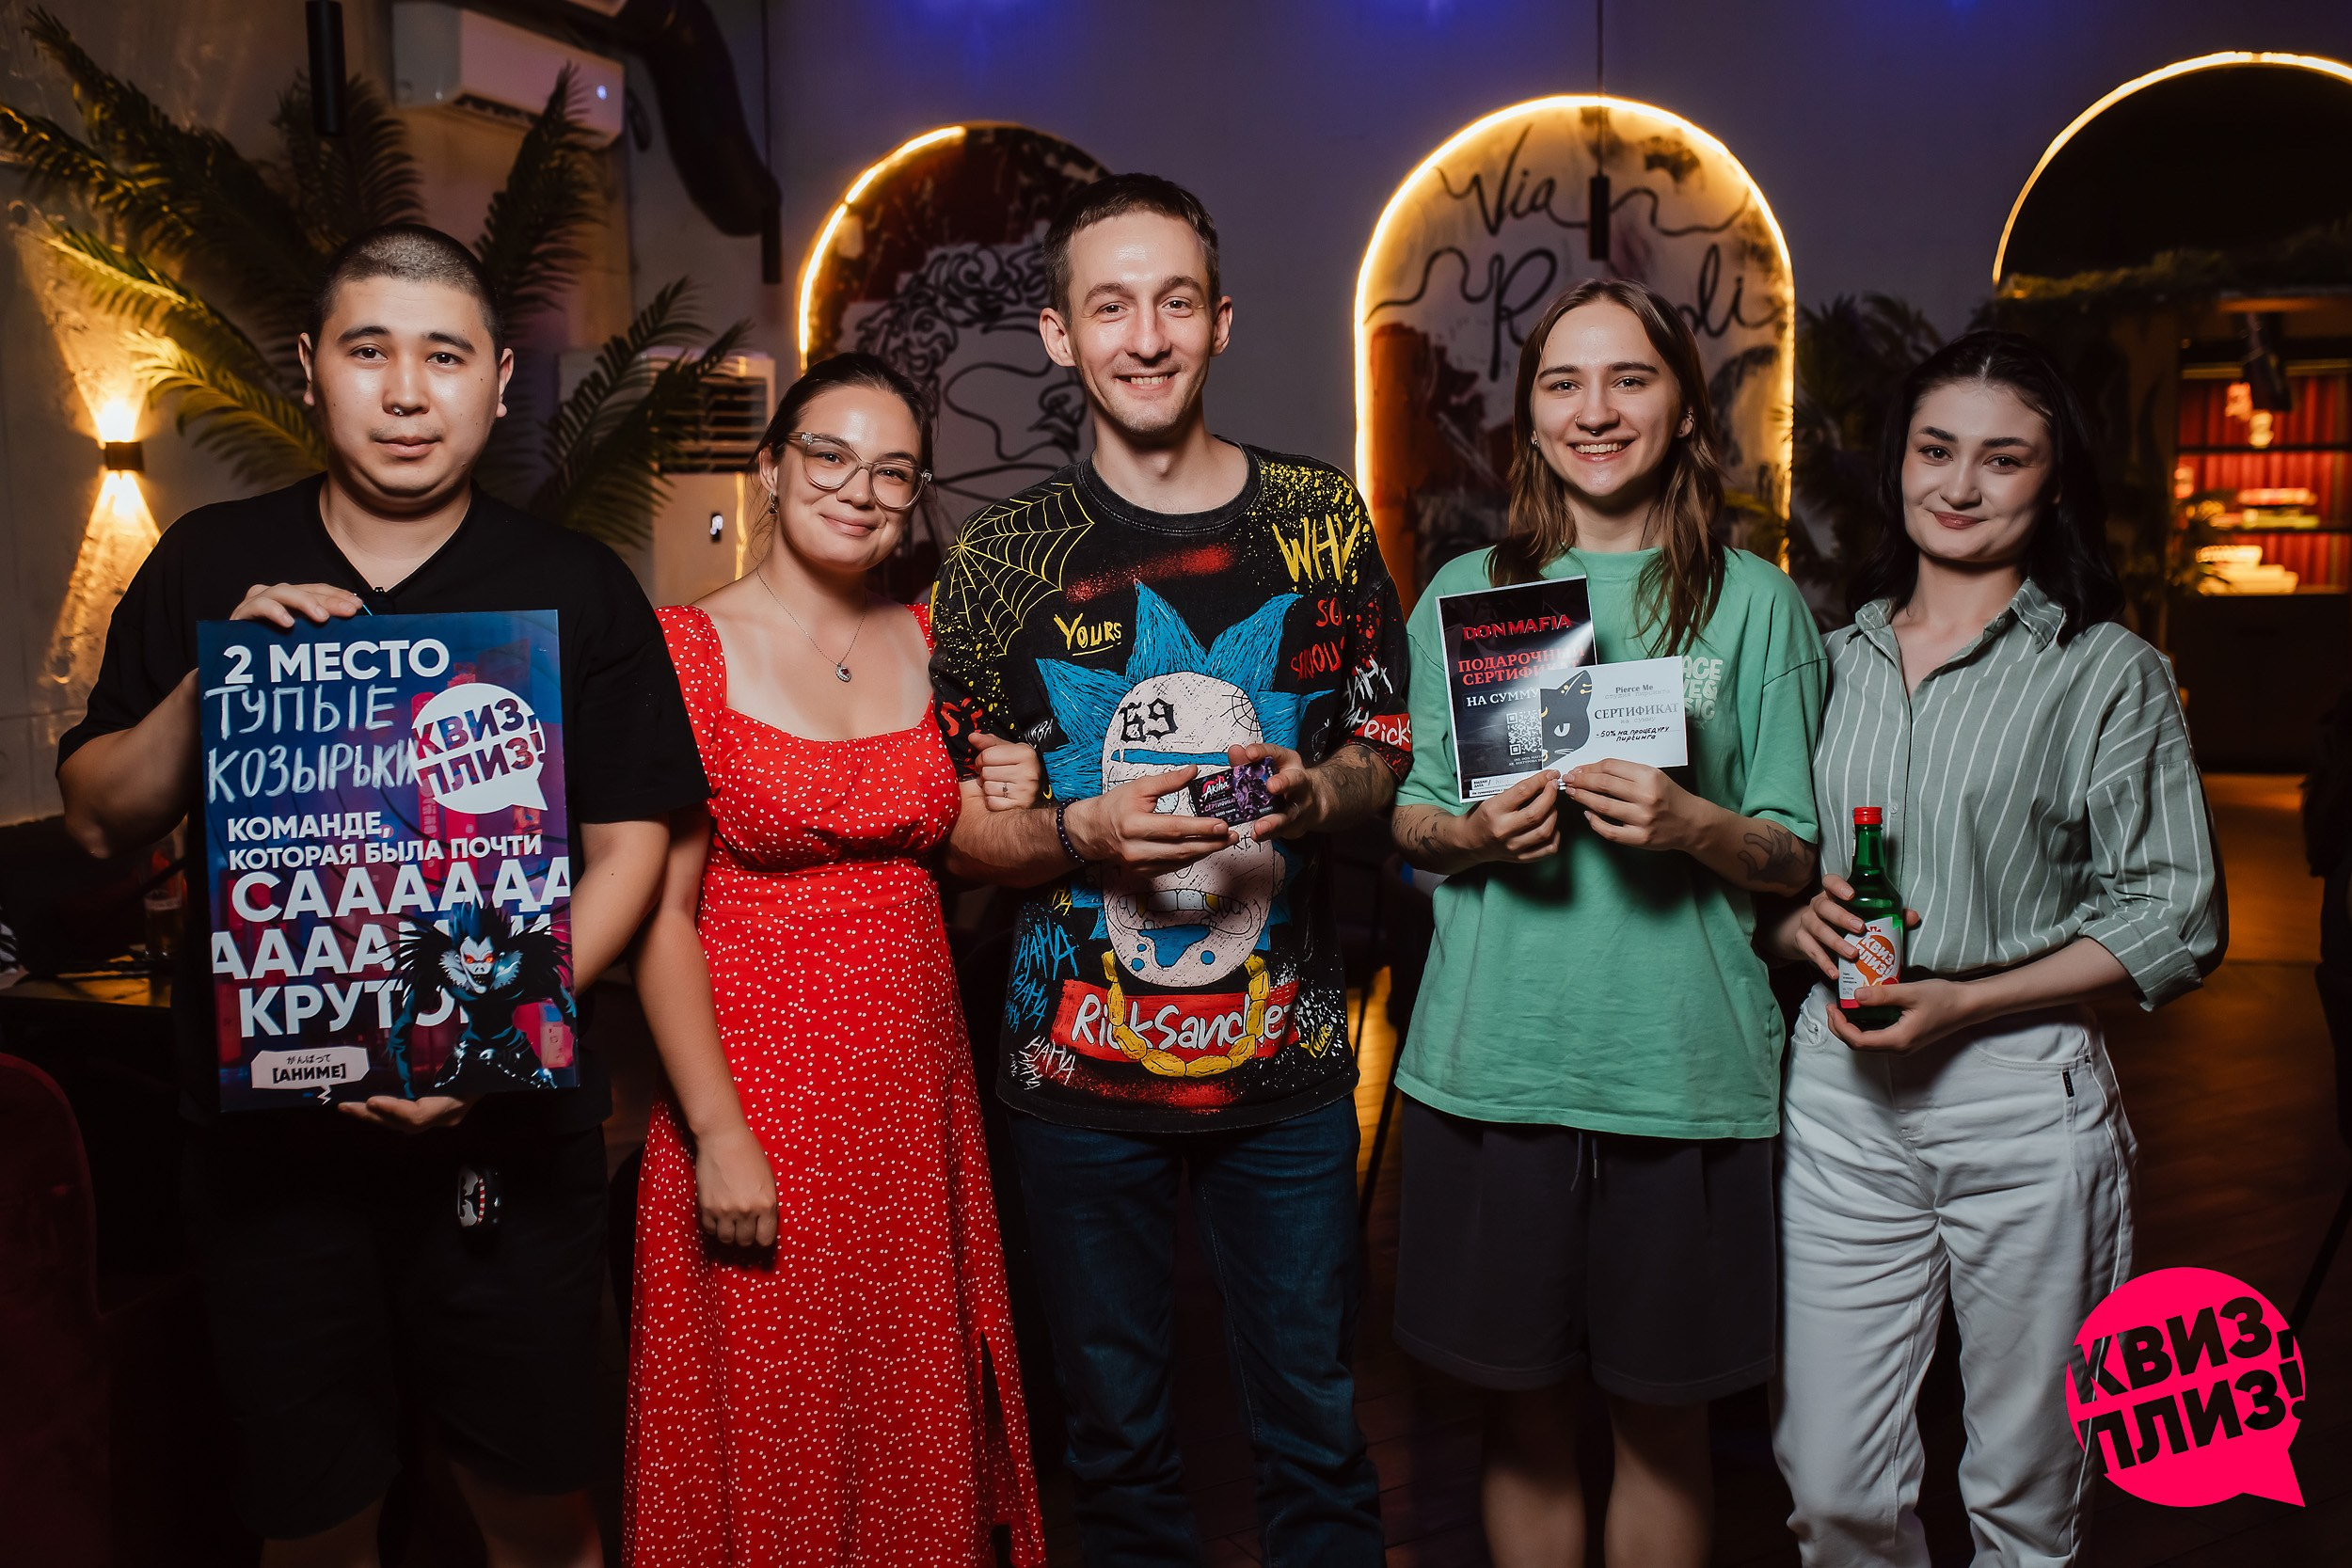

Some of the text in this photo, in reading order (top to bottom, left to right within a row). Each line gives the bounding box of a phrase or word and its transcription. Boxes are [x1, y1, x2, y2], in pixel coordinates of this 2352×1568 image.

[1272, 514, 1360, 584] WHY
[1316, 597, 1343, 627] SO
[1463, 614, 1572, 641] DON MAFIA
[223, 638, 450, 685] 2 МЕСТО
[1683, 656, 1723, 680] ACE
[204, 685, 398, 740] ТУПЫЕ
[1467, 688, 1540, 707] НА СУММУ
[1594, 703, 1679, 720] СЕРТИФИКАТ
[208, 737, 419, 803] КОЗЫРЬКИ
[417, 731, 545, 798] ПЛИЗ!
[228, 811, 390, 842] КОМАНДЕ,
[229, 834, 543, 871] КОТОРАЯ БЫЛА ПОЧТИ
[239, 979, 469, 1038] КРУТО
[272, 1063, 346, 1084] [АНИМЕ]
